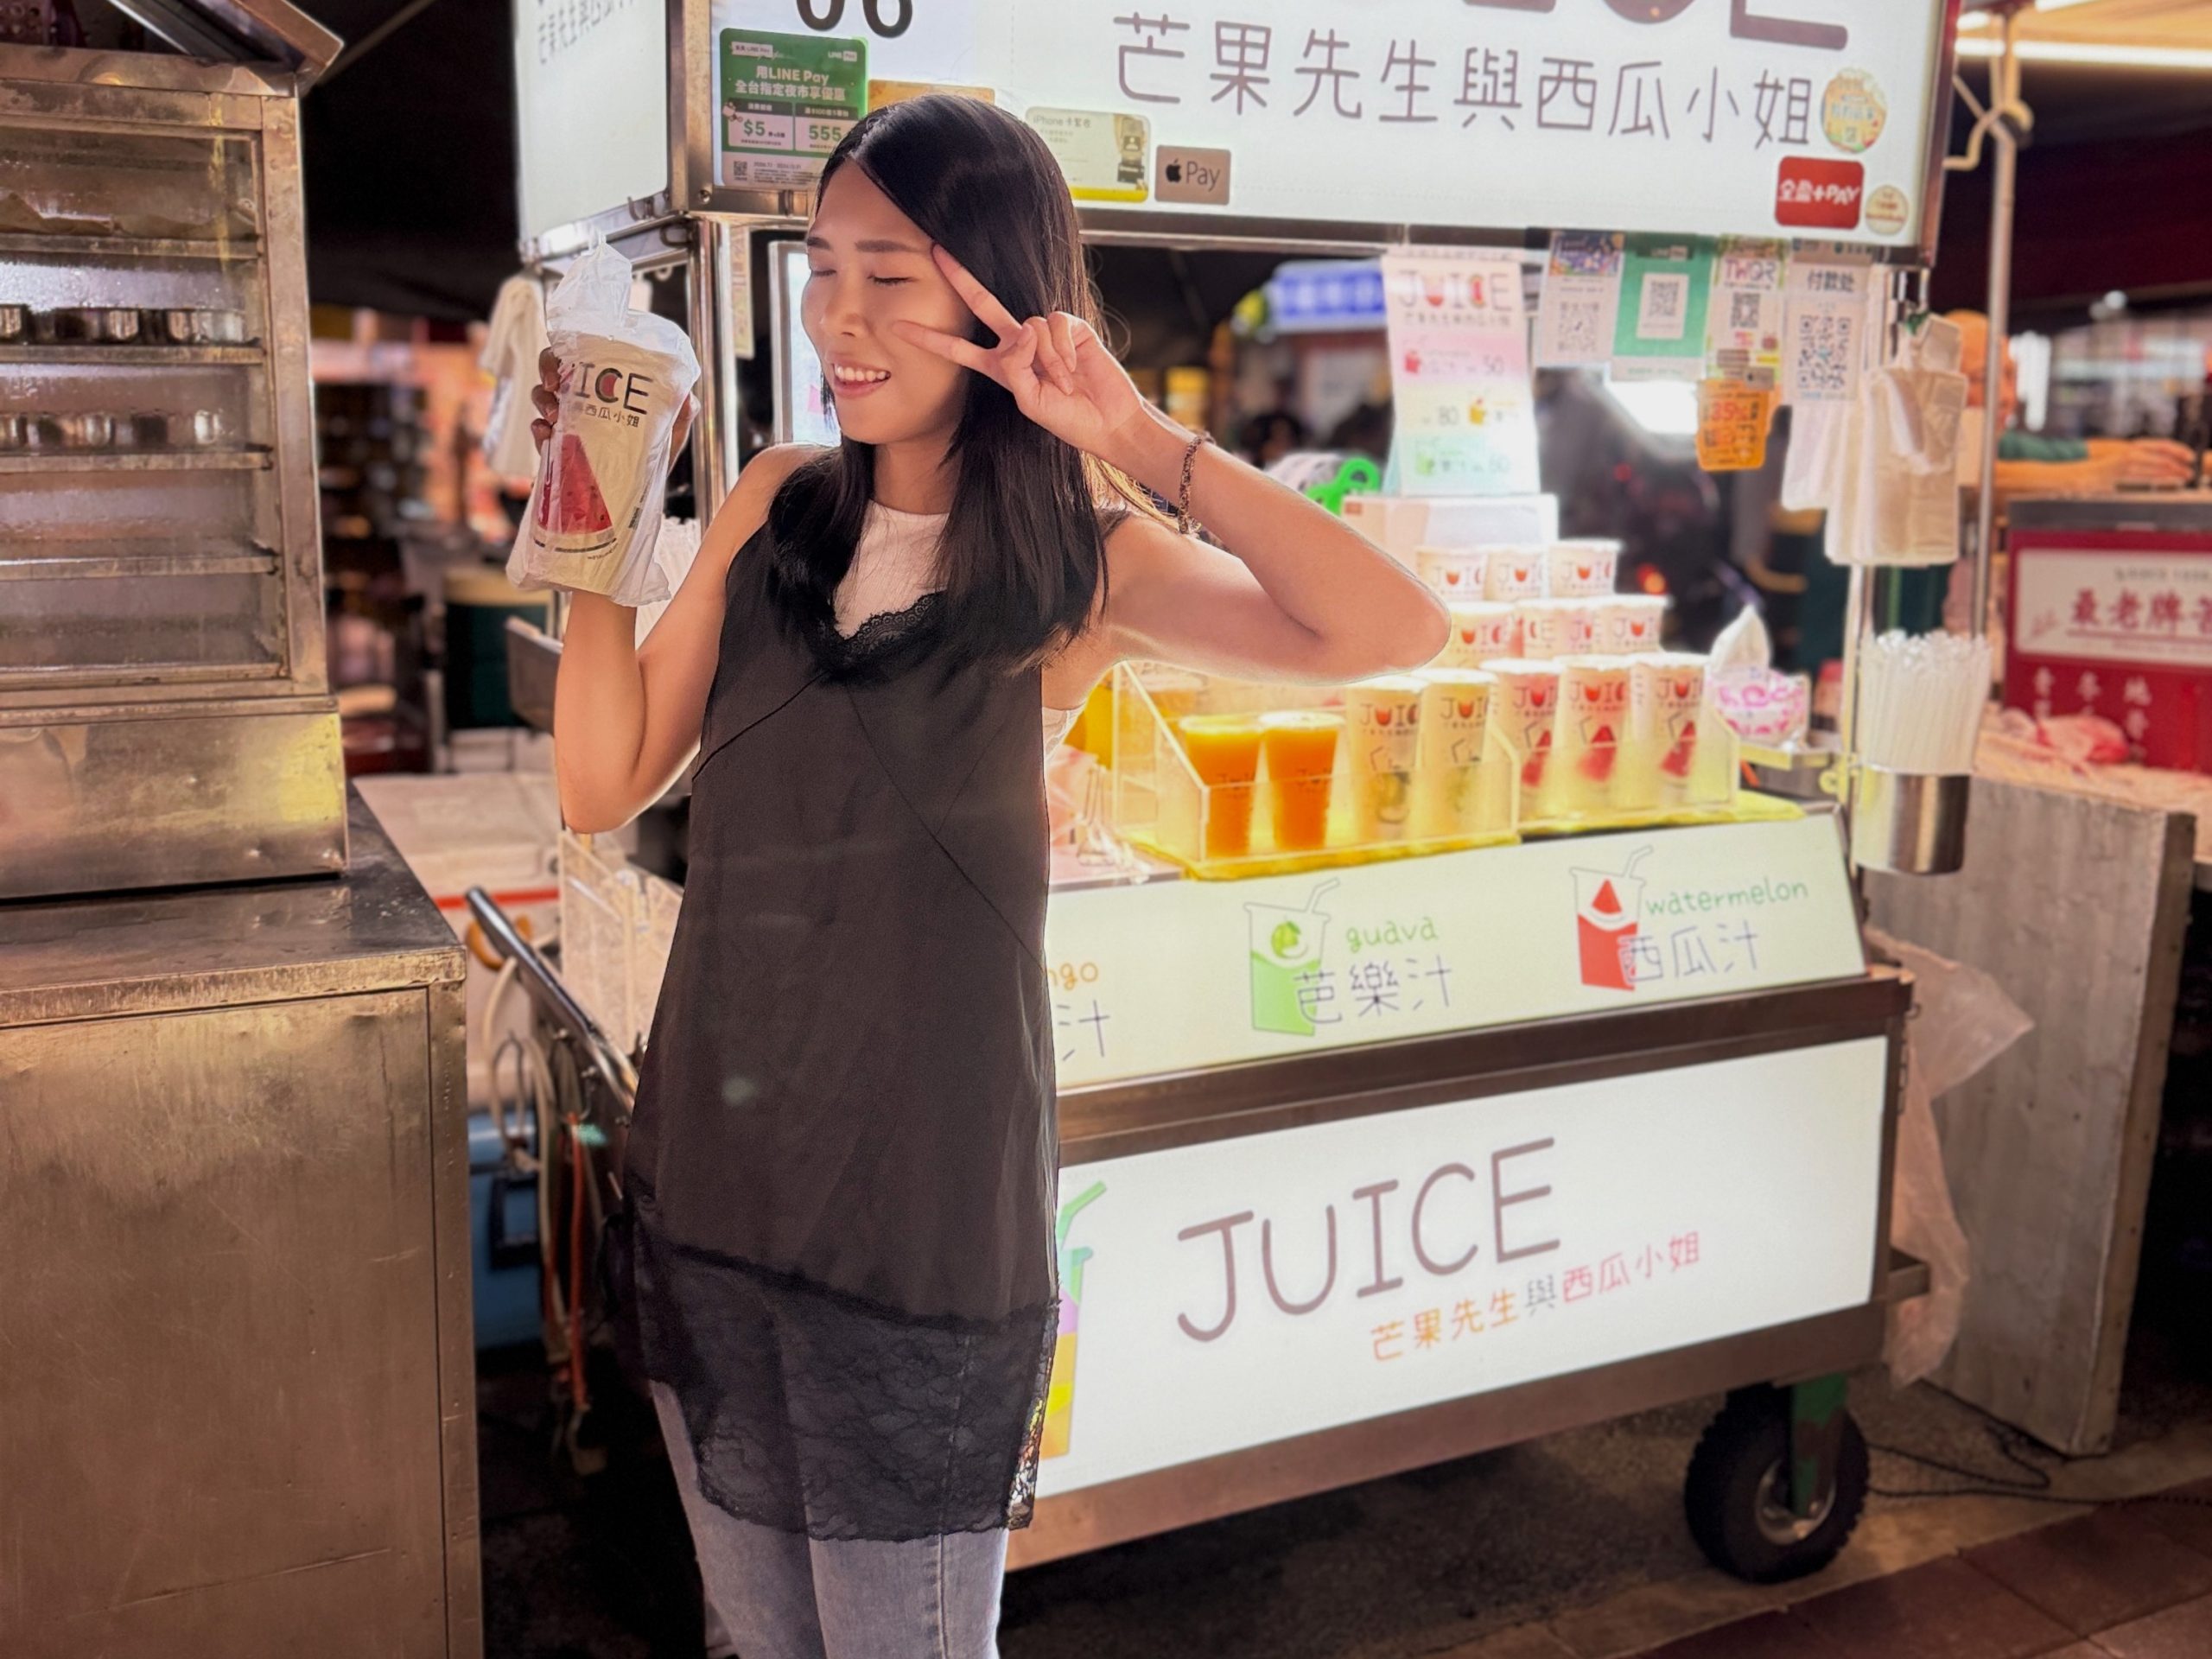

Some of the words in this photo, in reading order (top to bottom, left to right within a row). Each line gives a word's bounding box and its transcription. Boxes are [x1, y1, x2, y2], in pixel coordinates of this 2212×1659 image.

[756, 65, 800, 81] 用LINE
[804, 70, 830, 87] Pay
[1114, 12, 1812, 149] 芒果先生與西瓜小姐
[743, 118, 766, 137] $5
[809, 124, 842, 142] 555
[1033, 116, 1064, 126] iPhone
[1186, 161, 1221, 192] Pay
[563, 362, 653, 415] ICE
[571, 401, 640, 428] 西瓜小姐
[1645, 877, 1808, 917] watermelon
[1345, 918, 1439, 954] guava
[1620, 922, 1759, 985] 西瓜汁
[1294, 955, 1452, 1023] 芭樂汁
[1056, 1000, 1110, 1062] 汁
[1177, 1137, 1560, 1343] JUICE
[1372, 1232, 1700, 1361] 芒果先生與西瓜小姐
